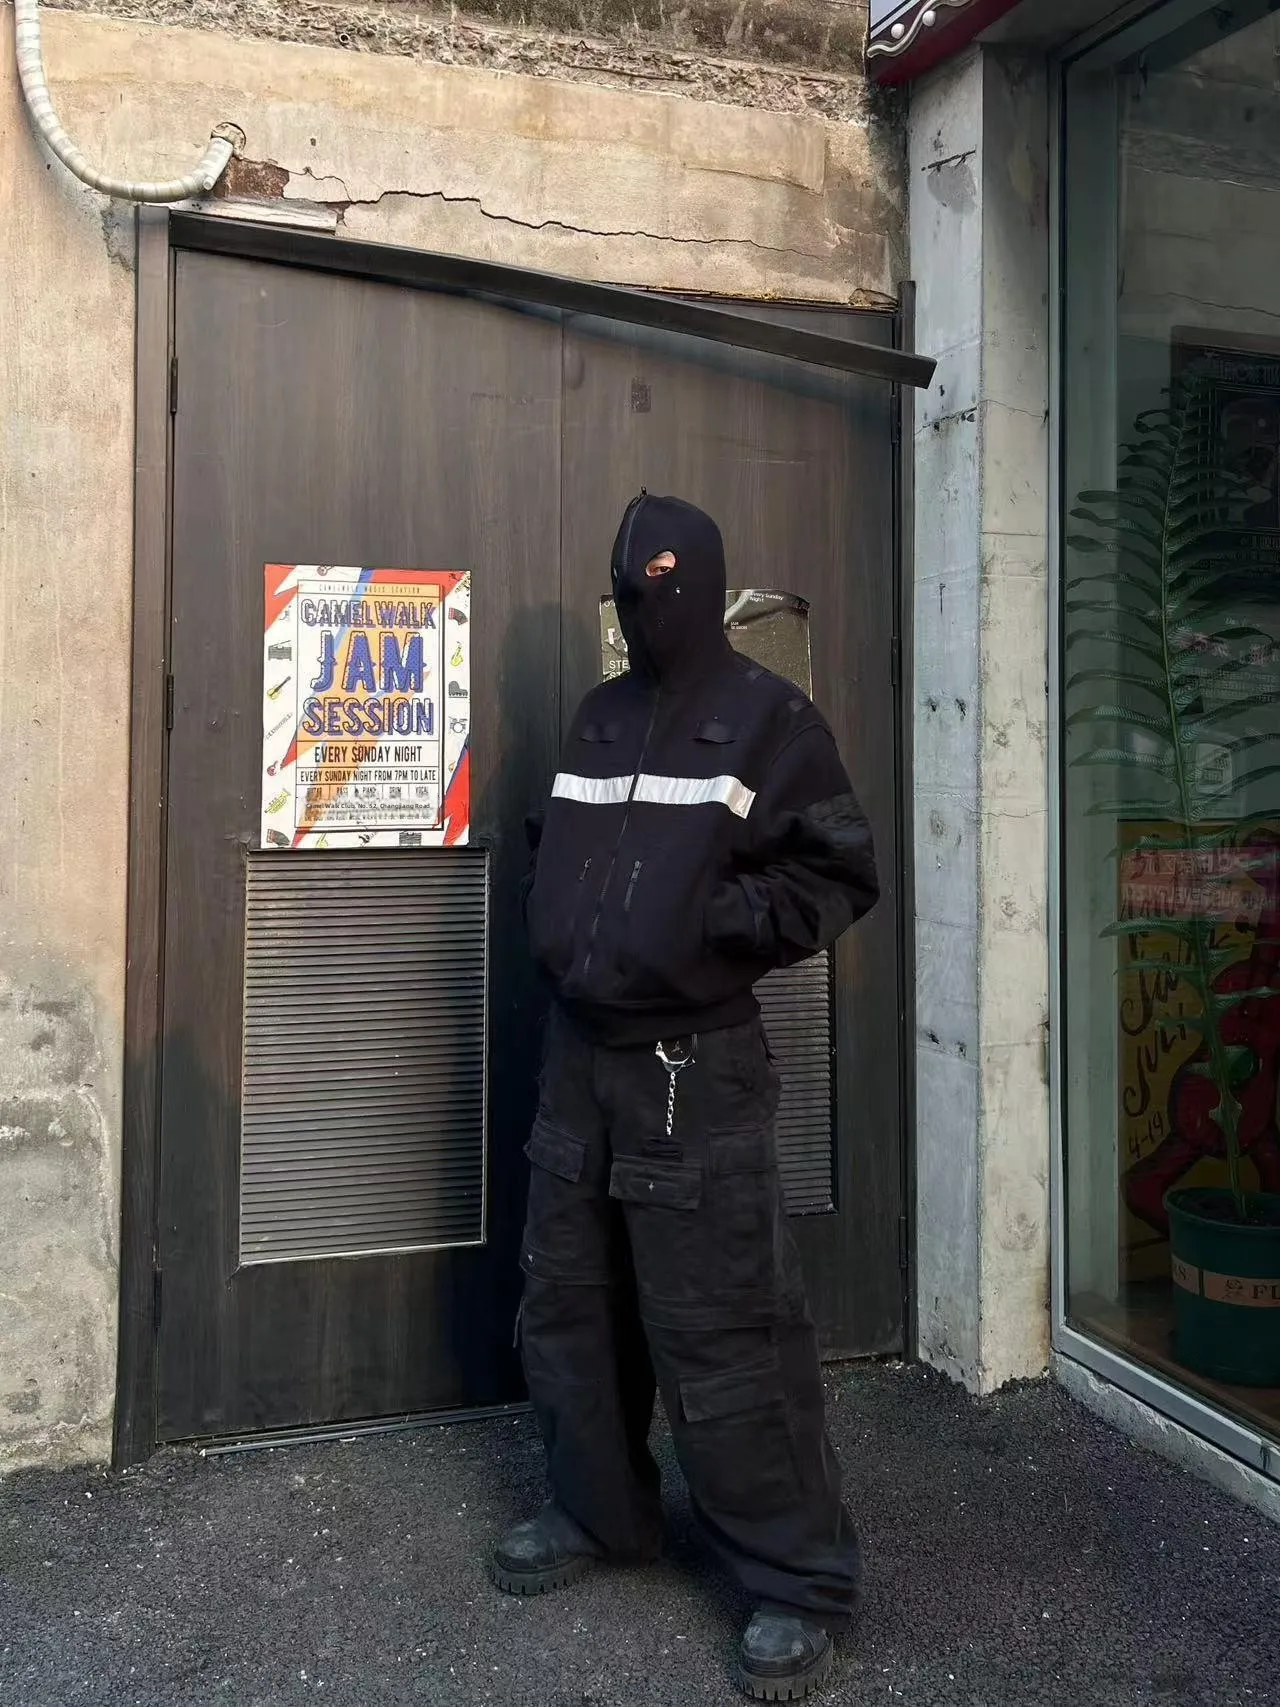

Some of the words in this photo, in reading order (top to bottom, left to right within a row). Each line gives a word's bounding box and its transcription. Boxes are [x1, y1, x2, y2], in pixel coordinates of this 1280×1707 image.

[765, 593, 784, 601] Sunday
[301, 598, 375, 629] CAMEL
[374, 600, 437, 630] WALK
[310, 630, 427, 693] JAM
[302, 697, 435, 737] SESSION
[314, 746, 348, 764] EVERY
[351, 745, 391, 763] SUNDAY
[394, 745, 423, 763] NIGHT
[300, 770, 323, 782] EVERY
[324, 770, 351, 782] SUNDAY
[353, 769, 373, 782] NIGHT
[374, 769, 393, 781] FROM
[394, 769, 409, 781] 7PM
[410, 769, 419, 781] TO
[420, 769, 437, 781] LATE
